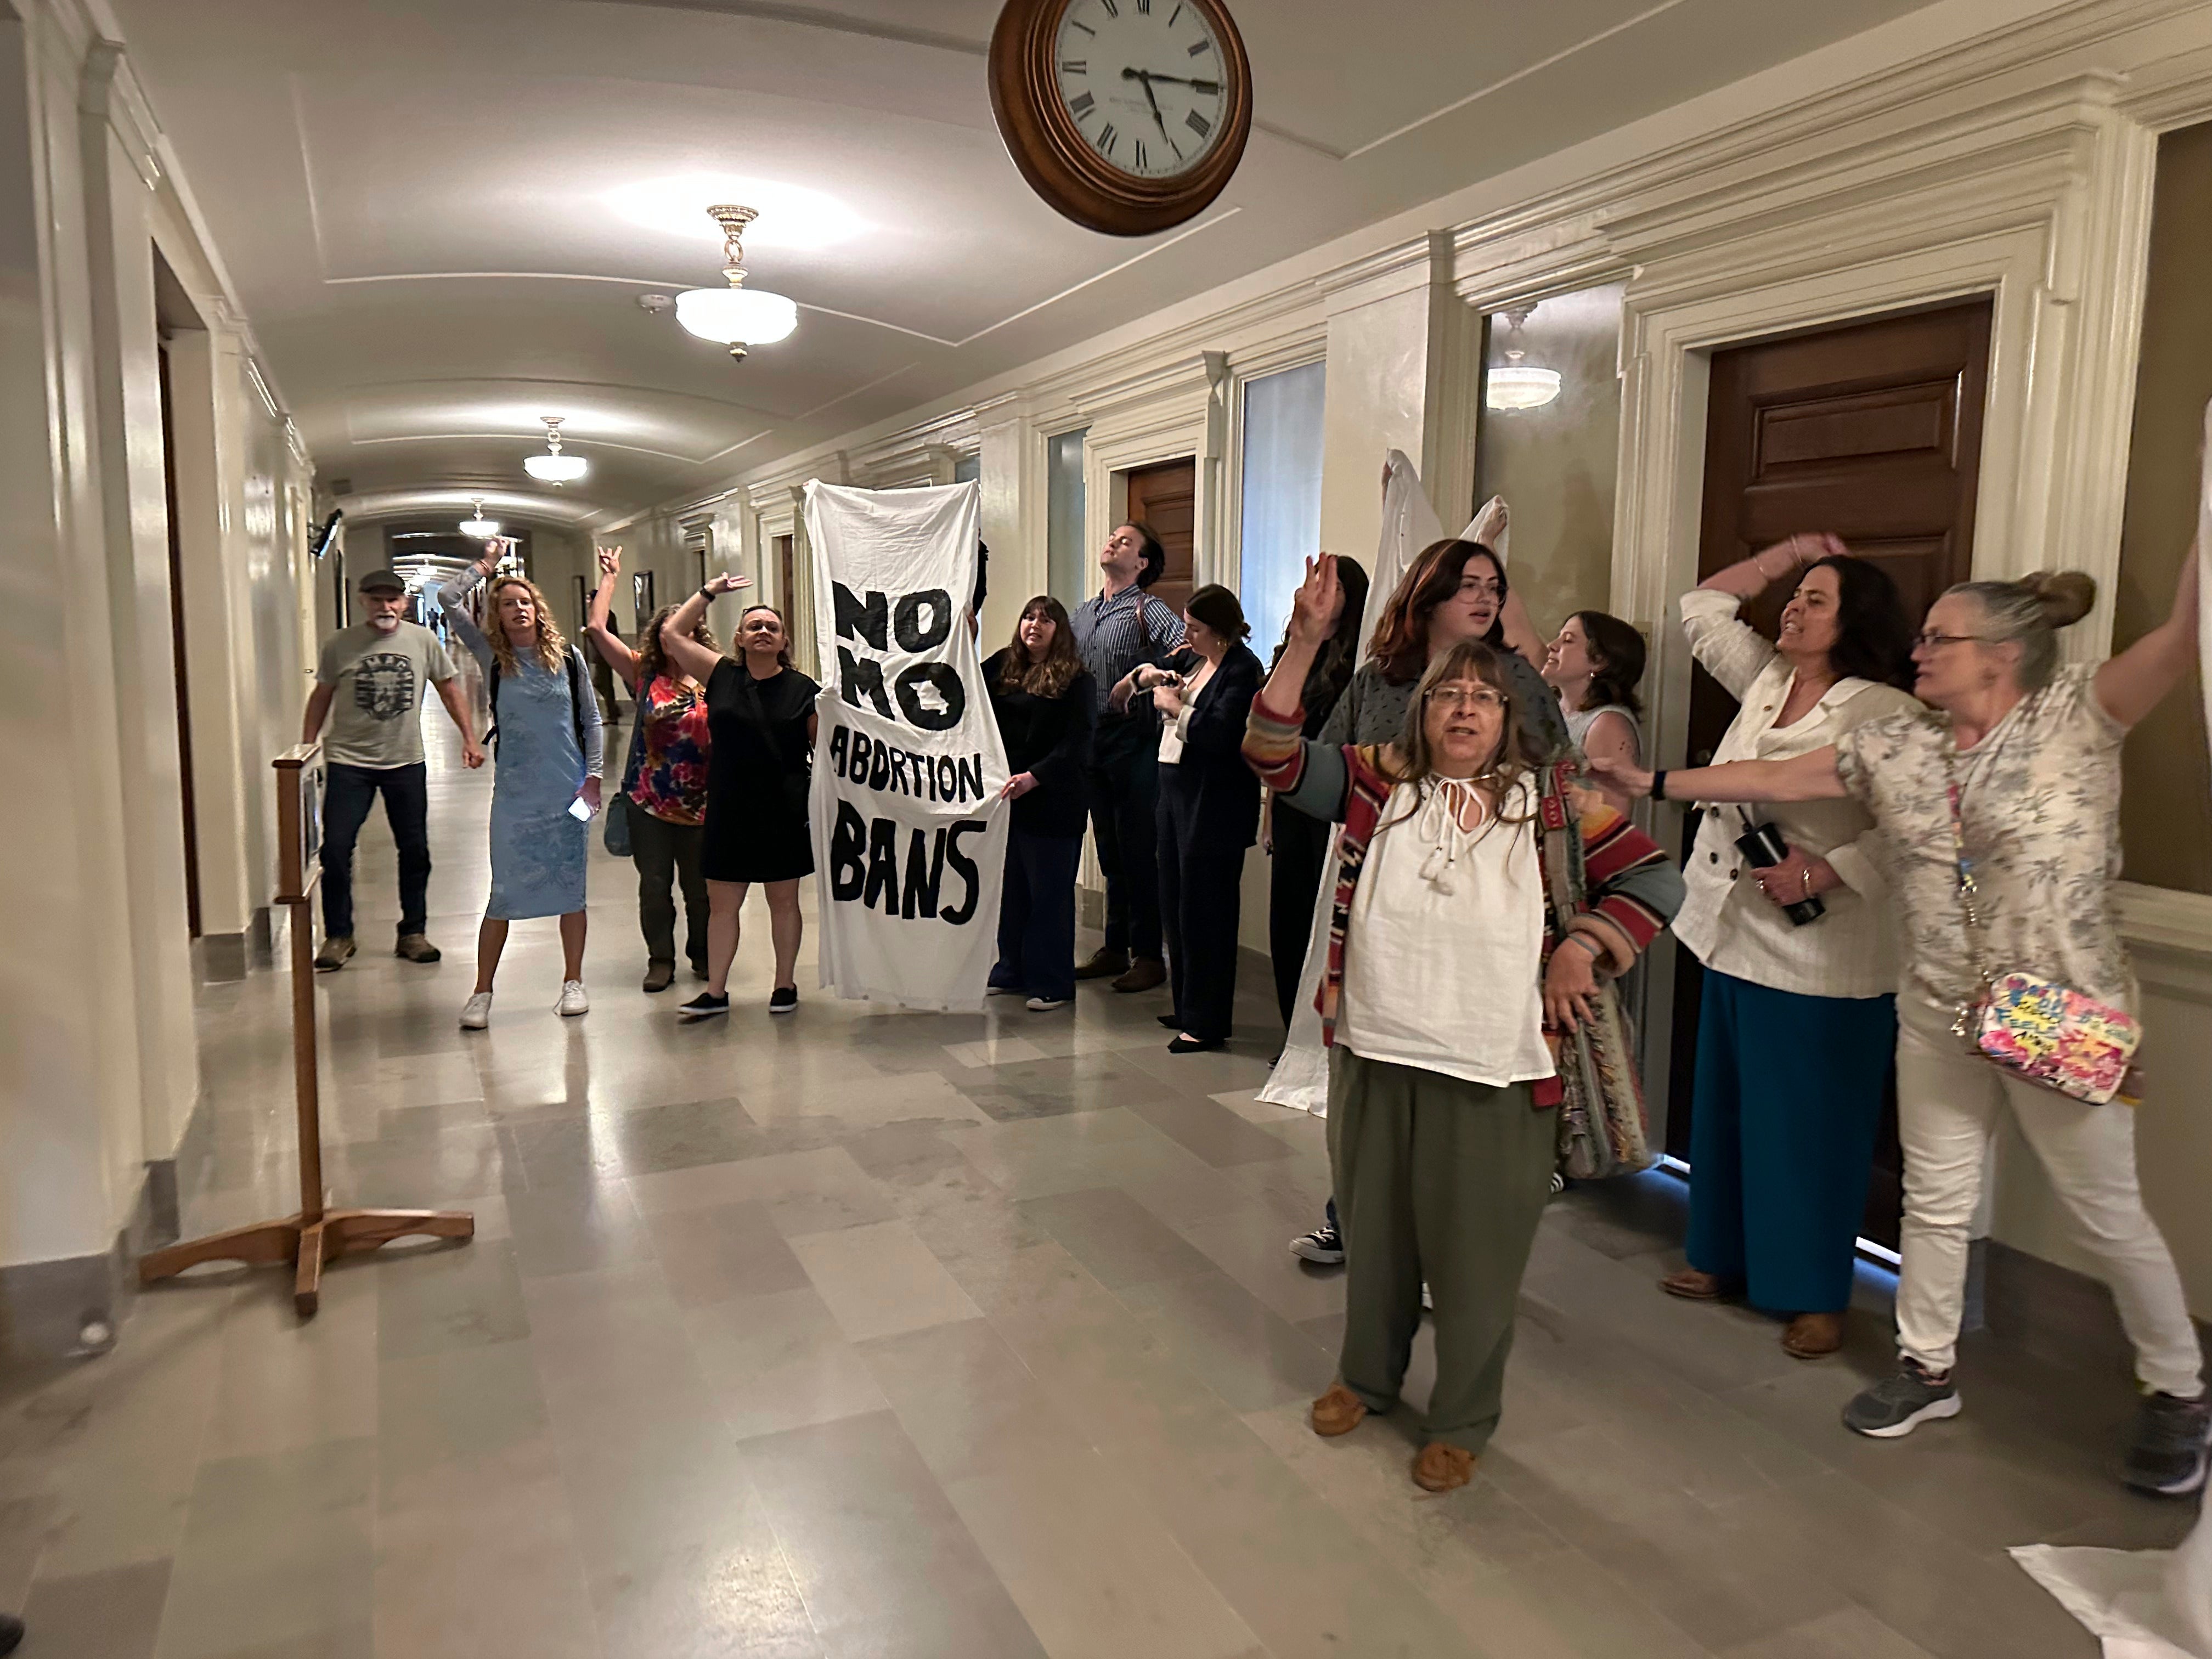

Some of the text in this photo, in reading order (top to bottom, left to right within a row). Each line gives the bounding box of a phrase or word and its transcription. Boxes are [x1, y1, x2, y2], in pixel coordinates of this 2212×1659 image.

[831, 579, 952, 654] NO
[837, 644, 966, 731] MO
[829, 724, 985, 803] ABORTION
[830, 797, 987, 926] BANS
